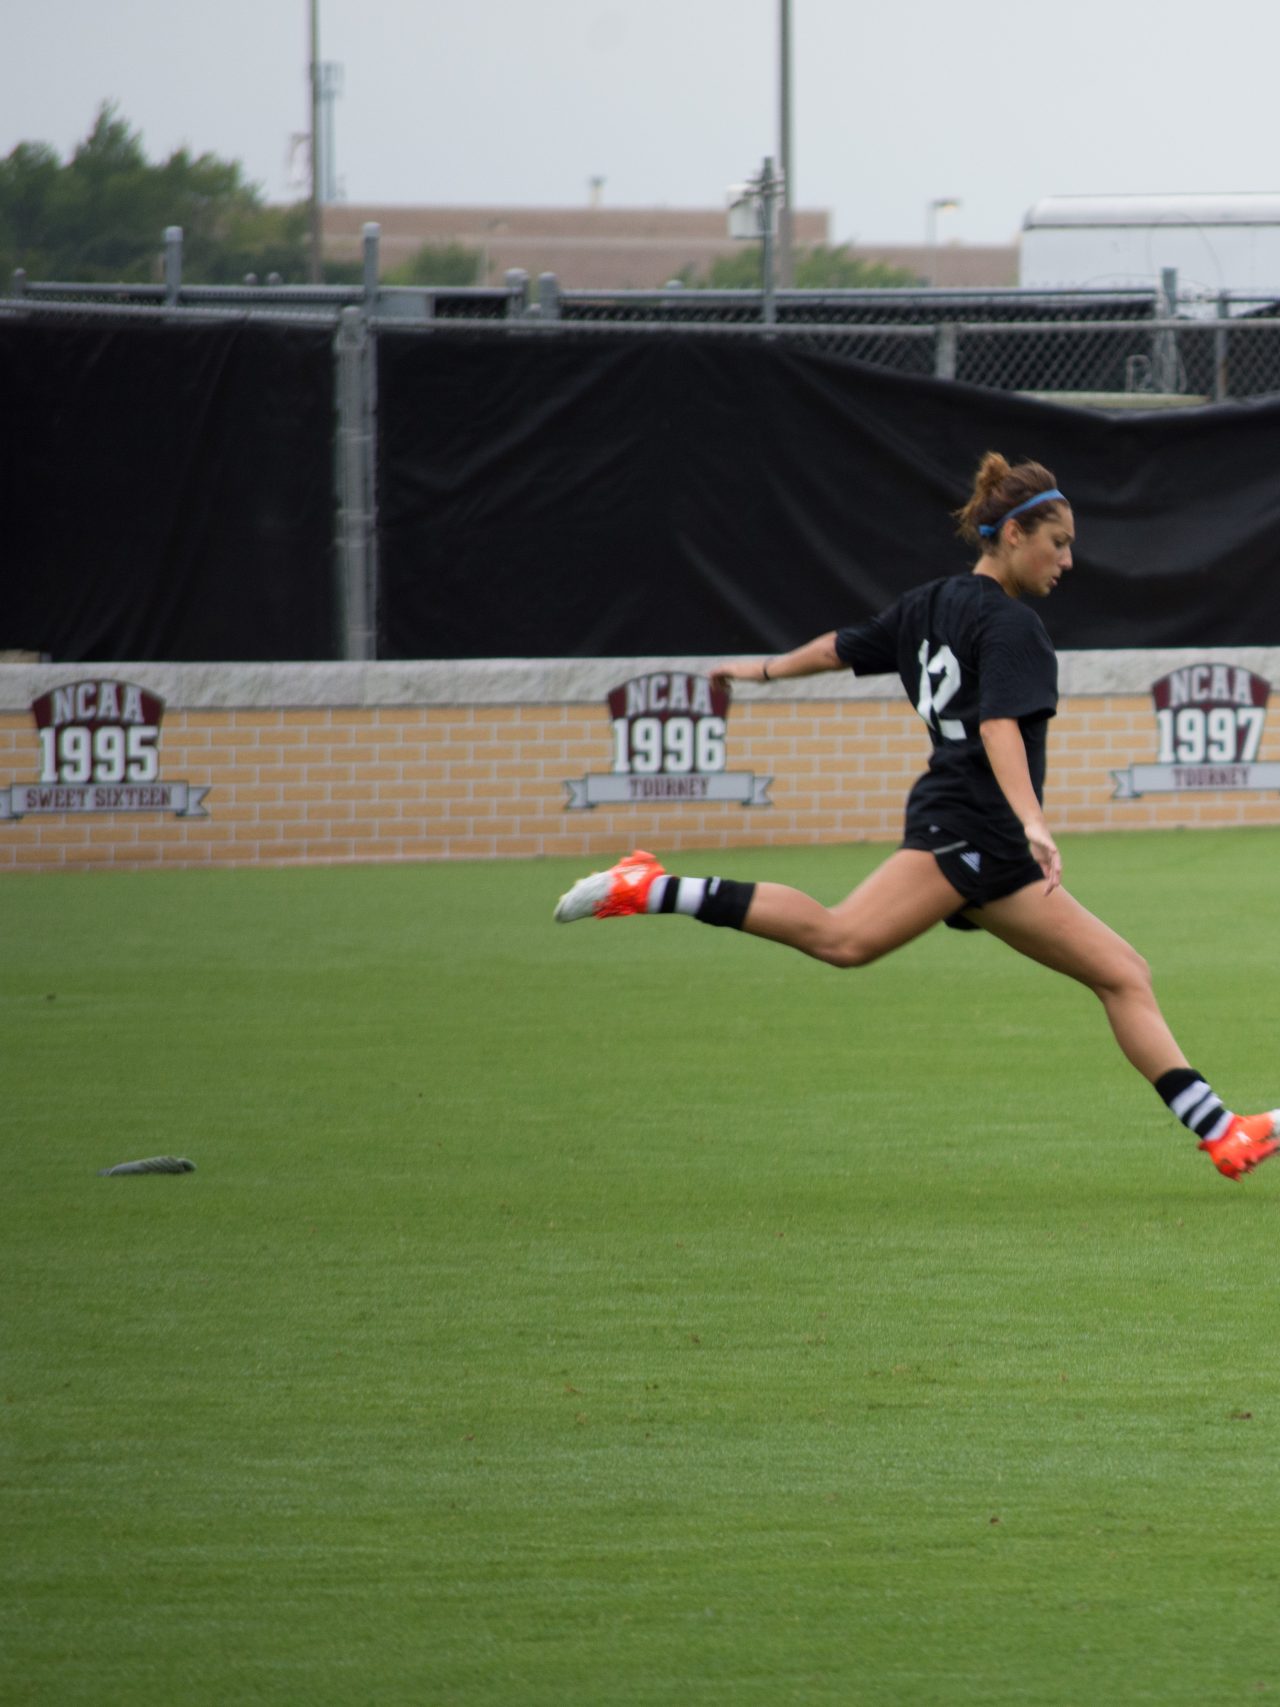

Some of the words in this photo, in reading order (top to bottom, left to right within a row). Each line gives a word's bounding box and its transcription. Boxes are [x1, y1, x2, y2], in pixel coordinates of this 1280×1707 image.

[53, 682, 145, 725] NCAA
[626, 674, 714, 718] NCAA
[1169, 665, 1254, 707] NCAA
[40, 726, 159, 783] 1995
[613, 716, 727, 773] 1996
[1157, 707, 1266, 763] 1997
[26, 787, 89, 808] SWEET
[94, 786, 173, 808] SIXTEEN
[629, 776, 711, 797] TOURNEY
[1173, 766, 1250, 787] TOURNEY
